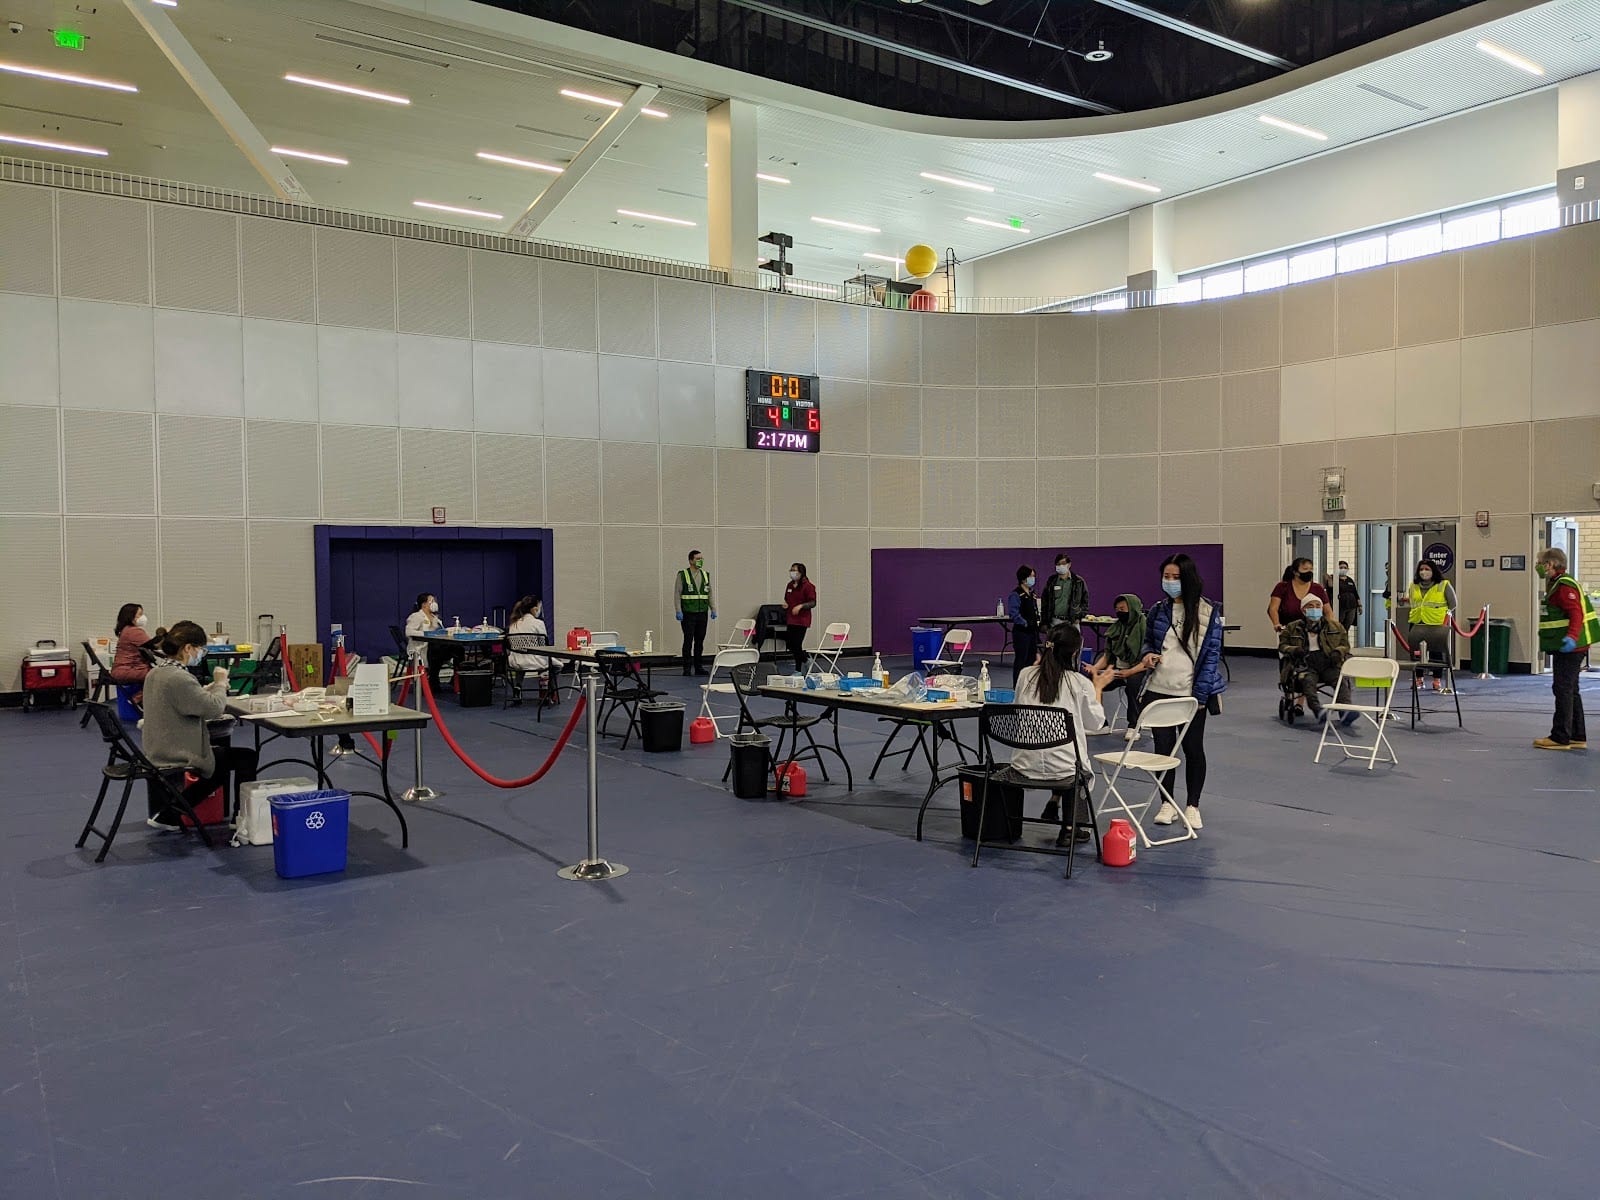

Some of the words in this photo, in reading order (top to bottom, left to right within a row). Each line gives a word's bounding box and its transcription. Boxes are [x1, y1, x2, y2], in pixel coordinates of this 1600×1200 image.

[757, 396, 772, 404] HOME
[768, 407, 779, 428] 4
[782, 407, 789, 419] 8
[808, 410, 819, 430] 6
[757, 431, 807, 449] 2:17PM
[1327, 498, 1340, 509] EXIT
